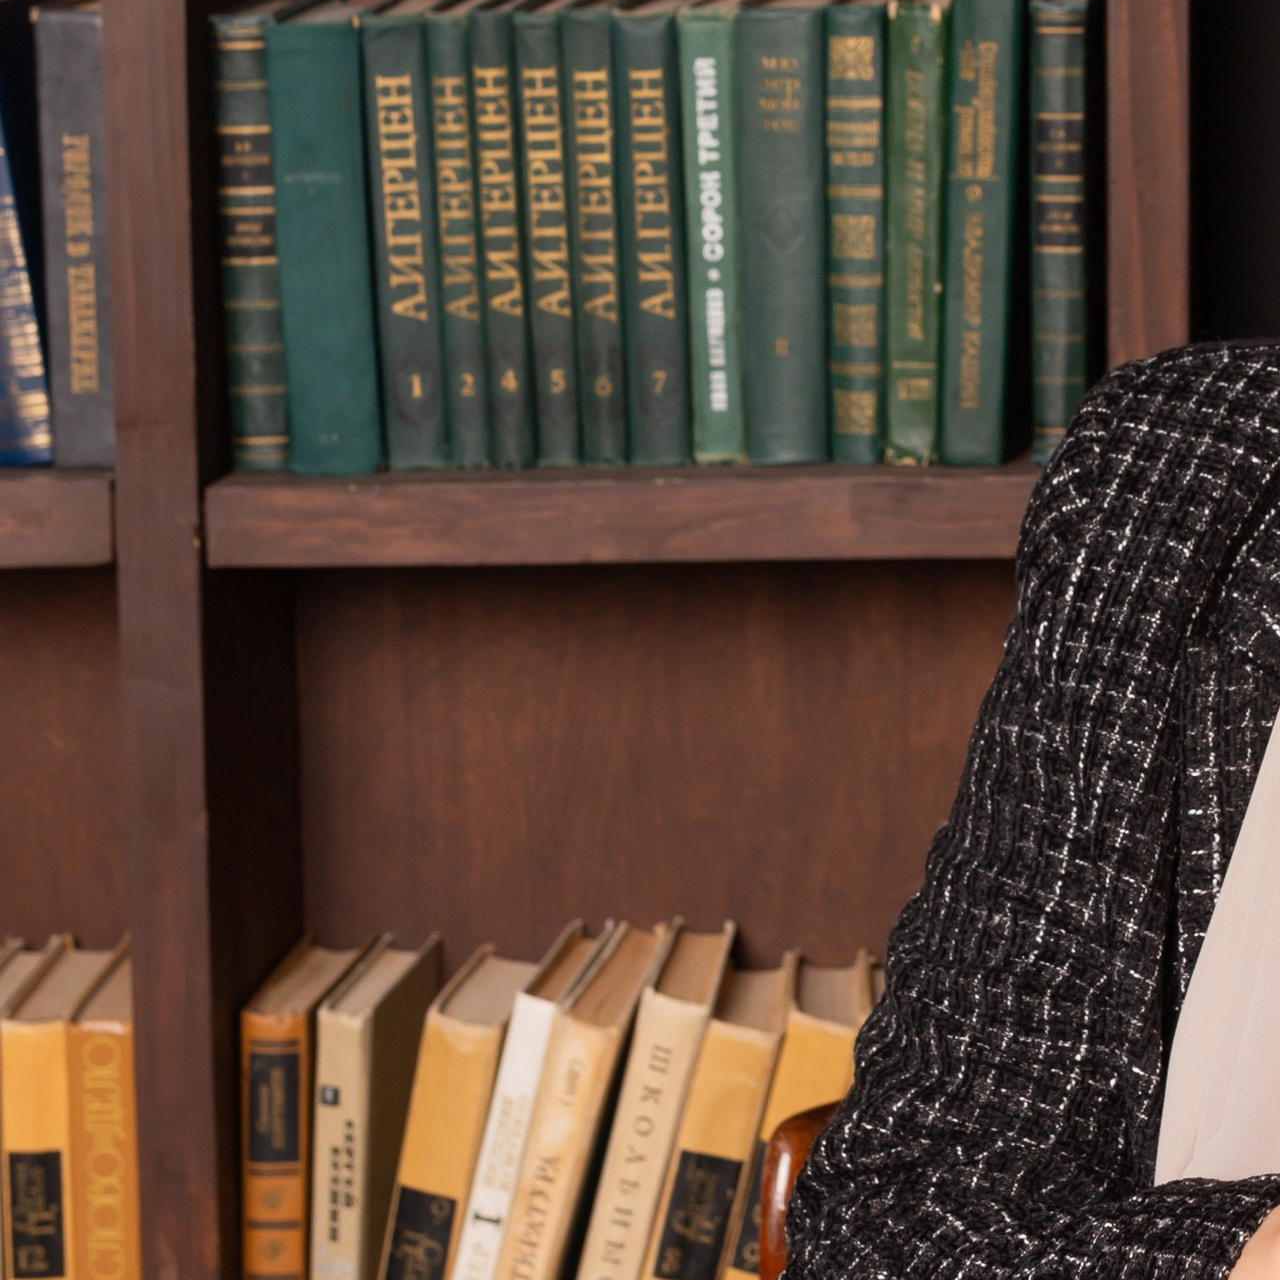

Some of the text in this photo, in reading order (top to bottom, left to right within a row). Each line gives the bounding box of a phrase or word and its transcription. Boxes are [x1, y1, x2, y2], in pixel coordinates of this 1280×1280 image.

[693, 56, 721, 166] ТРЕТИЙ
[698, 171, 725, 263] СОРОК
[410, 372, 423, 398] 1
[460, 371, 476, 397] 2
[500, 368, 519, 393] 4
[551, 368, 567, 394] 5
[651, 370, 668, 395] 7
